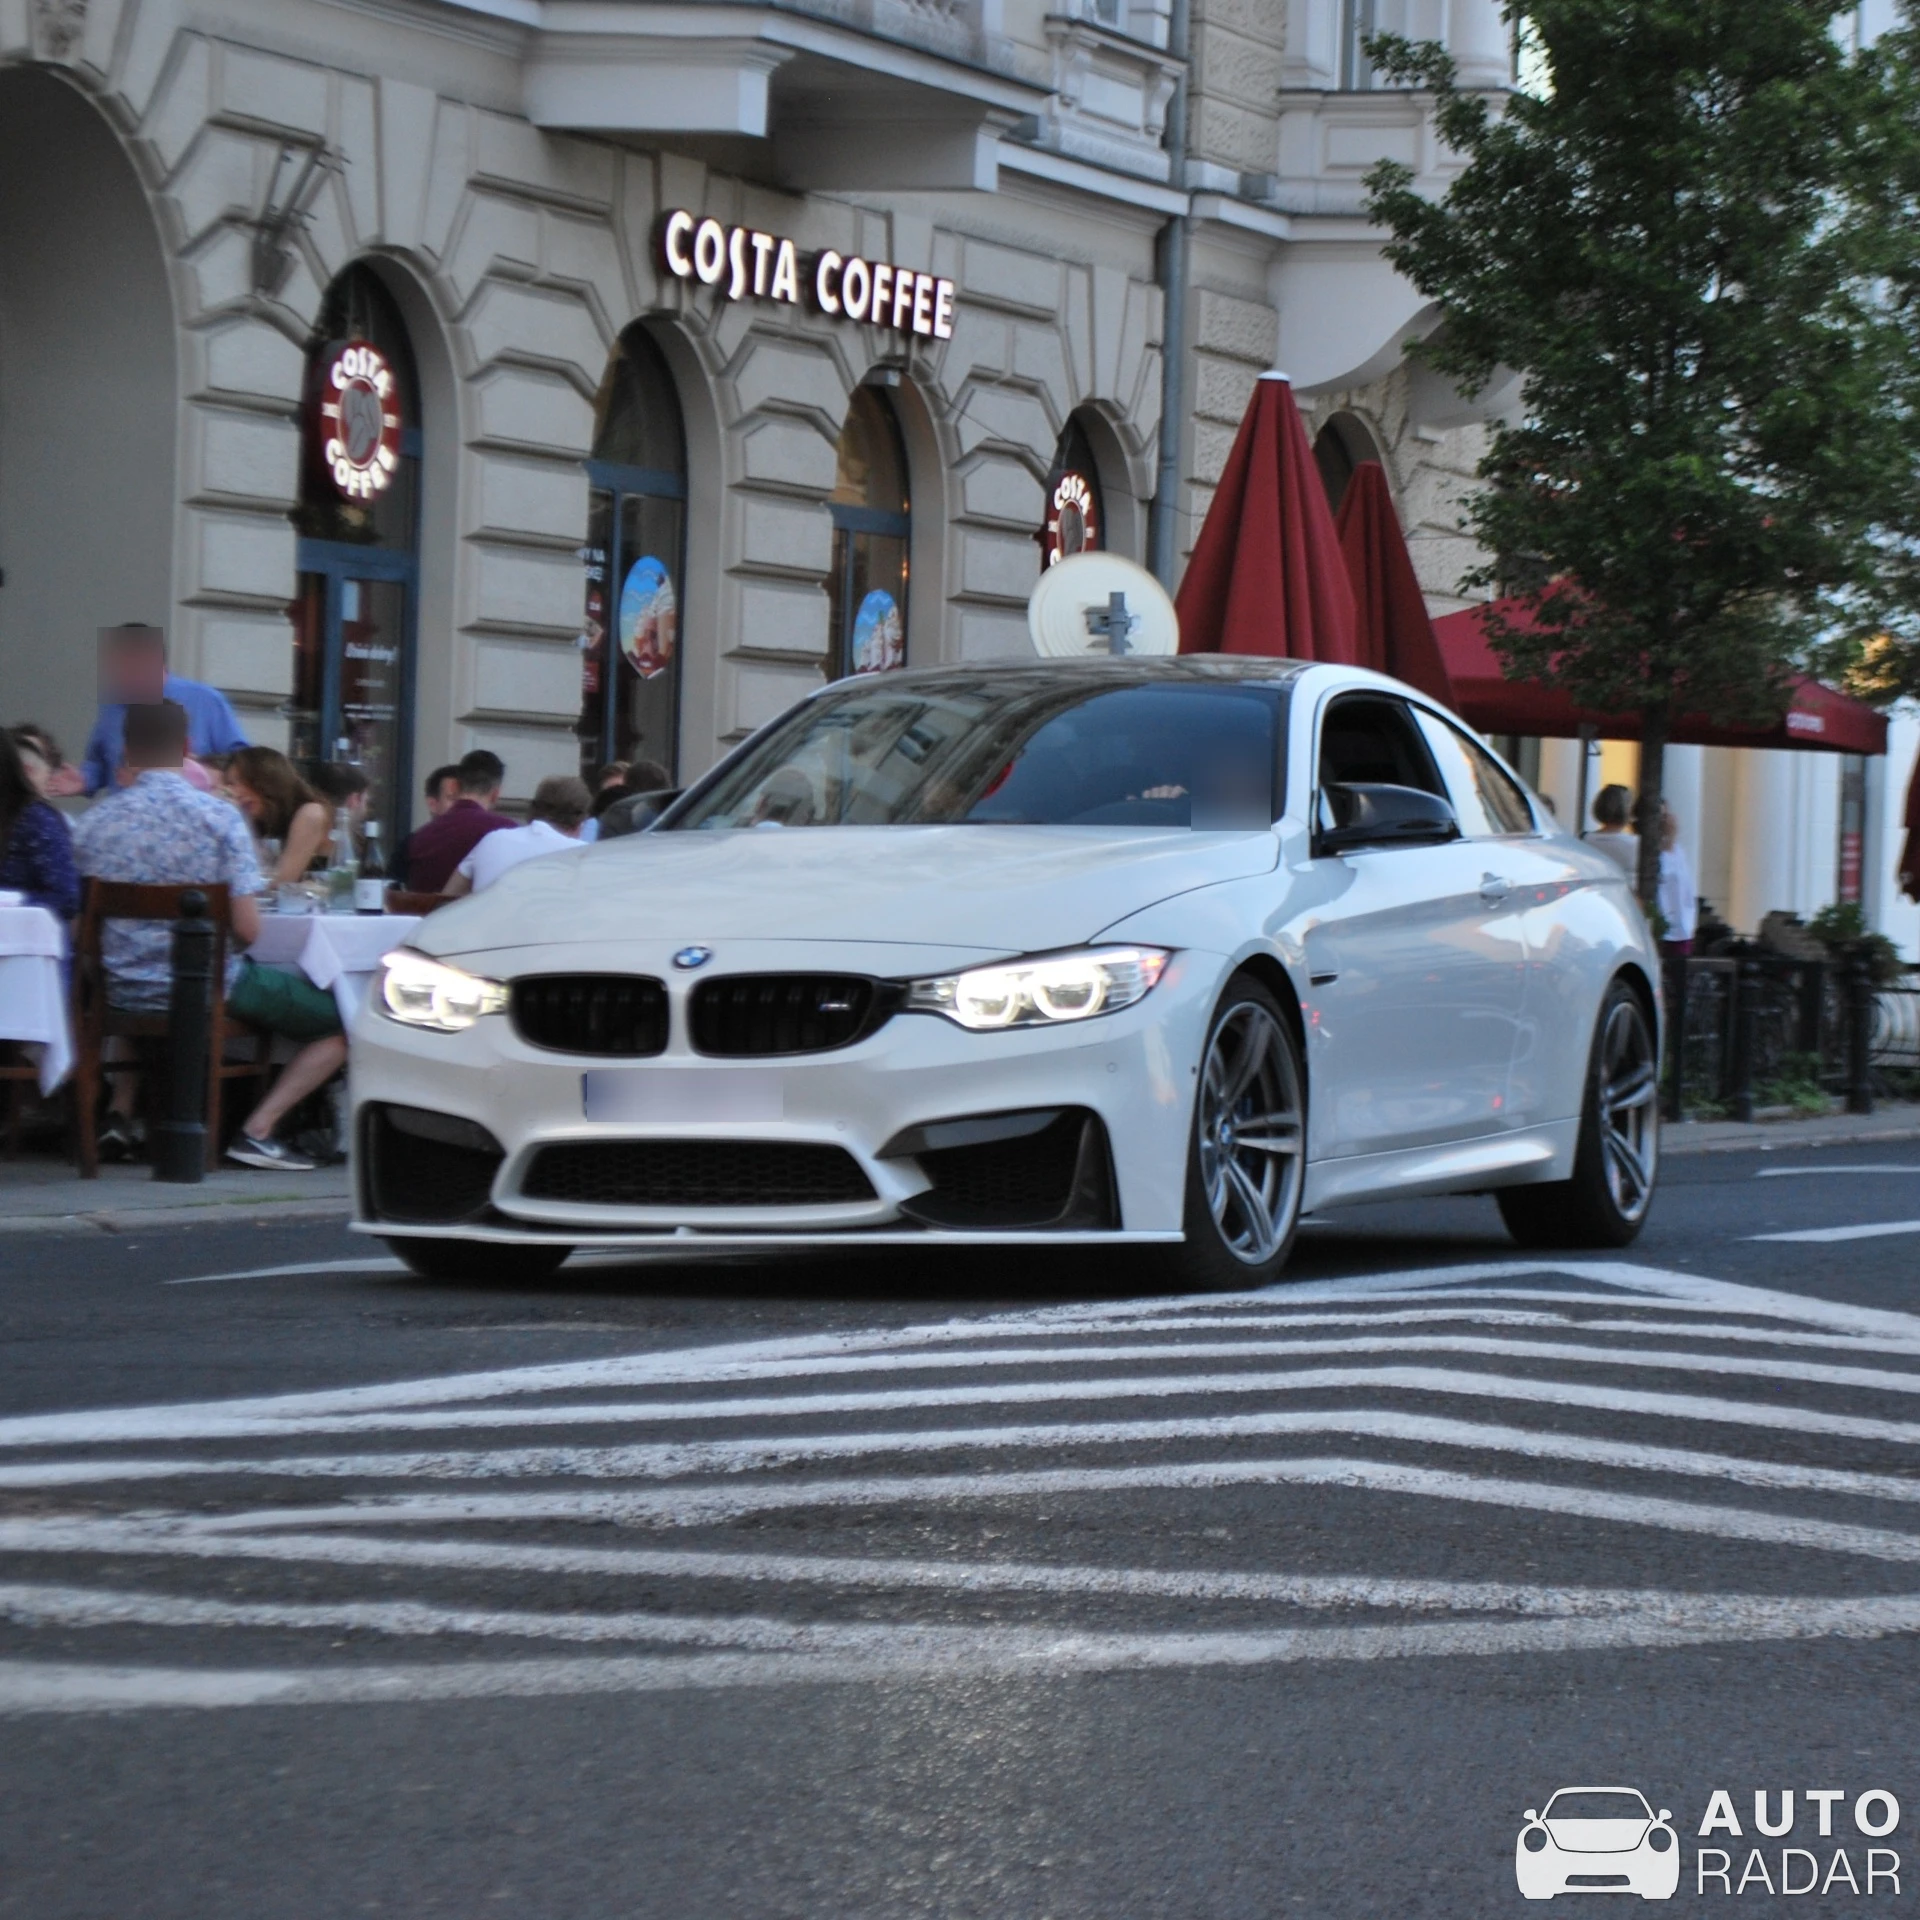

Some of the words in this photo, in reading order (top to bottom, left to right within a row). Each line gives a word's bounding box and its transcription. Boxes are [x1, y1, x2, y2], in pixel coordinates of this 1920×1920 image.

[665, 210, 797, 304] COSTA
[816, 250, 954, 339] COFFEE
[330, 347, 394, 398] COSTA
